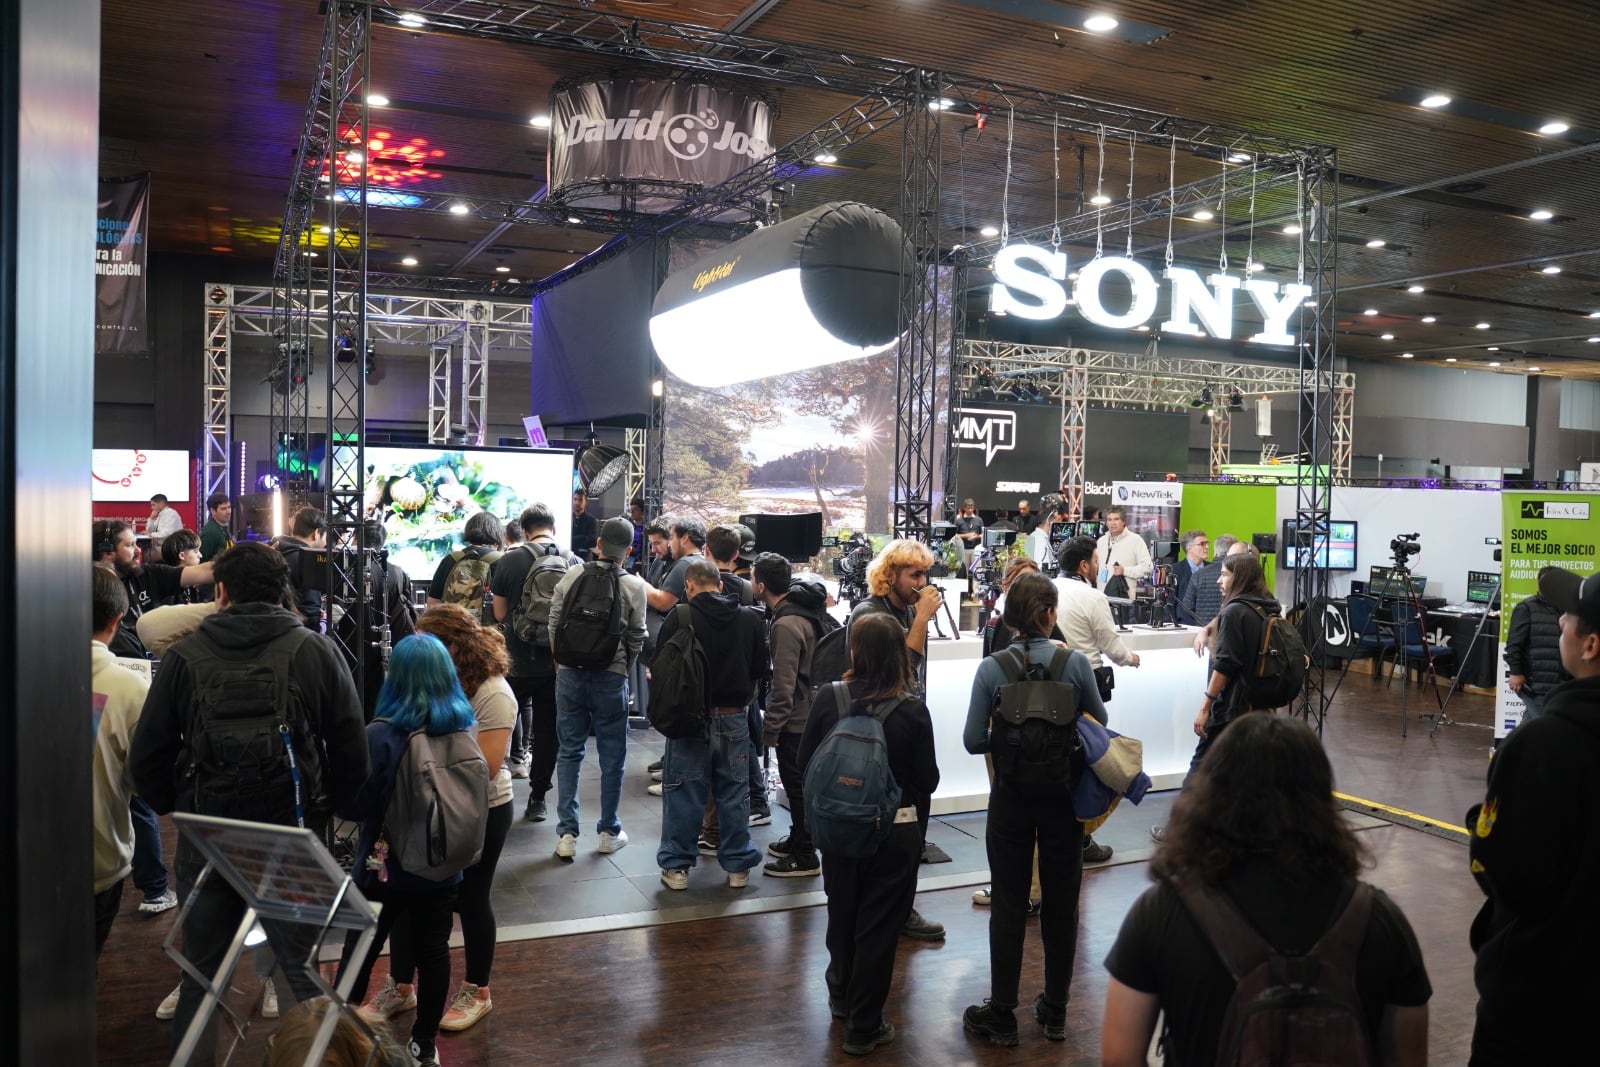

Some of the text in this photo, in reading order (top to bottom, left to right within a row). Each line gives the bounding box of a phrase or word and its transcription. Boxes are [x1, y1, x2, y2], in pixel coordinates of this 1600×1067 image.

[567, 109, 664, 147] David
[97, 248, 122, 261] ra la
[95, 261, 141, 276] NICACIÓN
[990, 244, 1312, 345] SONY
[1131, 490, 1173, 499] NewTek
[1511, 529, 1548, 541] SOMOS
[1511, 543, 1596, 556] EL MEJOR SOCIO
[1510, 560, 1594, 570] PARA TUS PROYECTOS
[1510, 570, 1537, 579] AUDIOV
